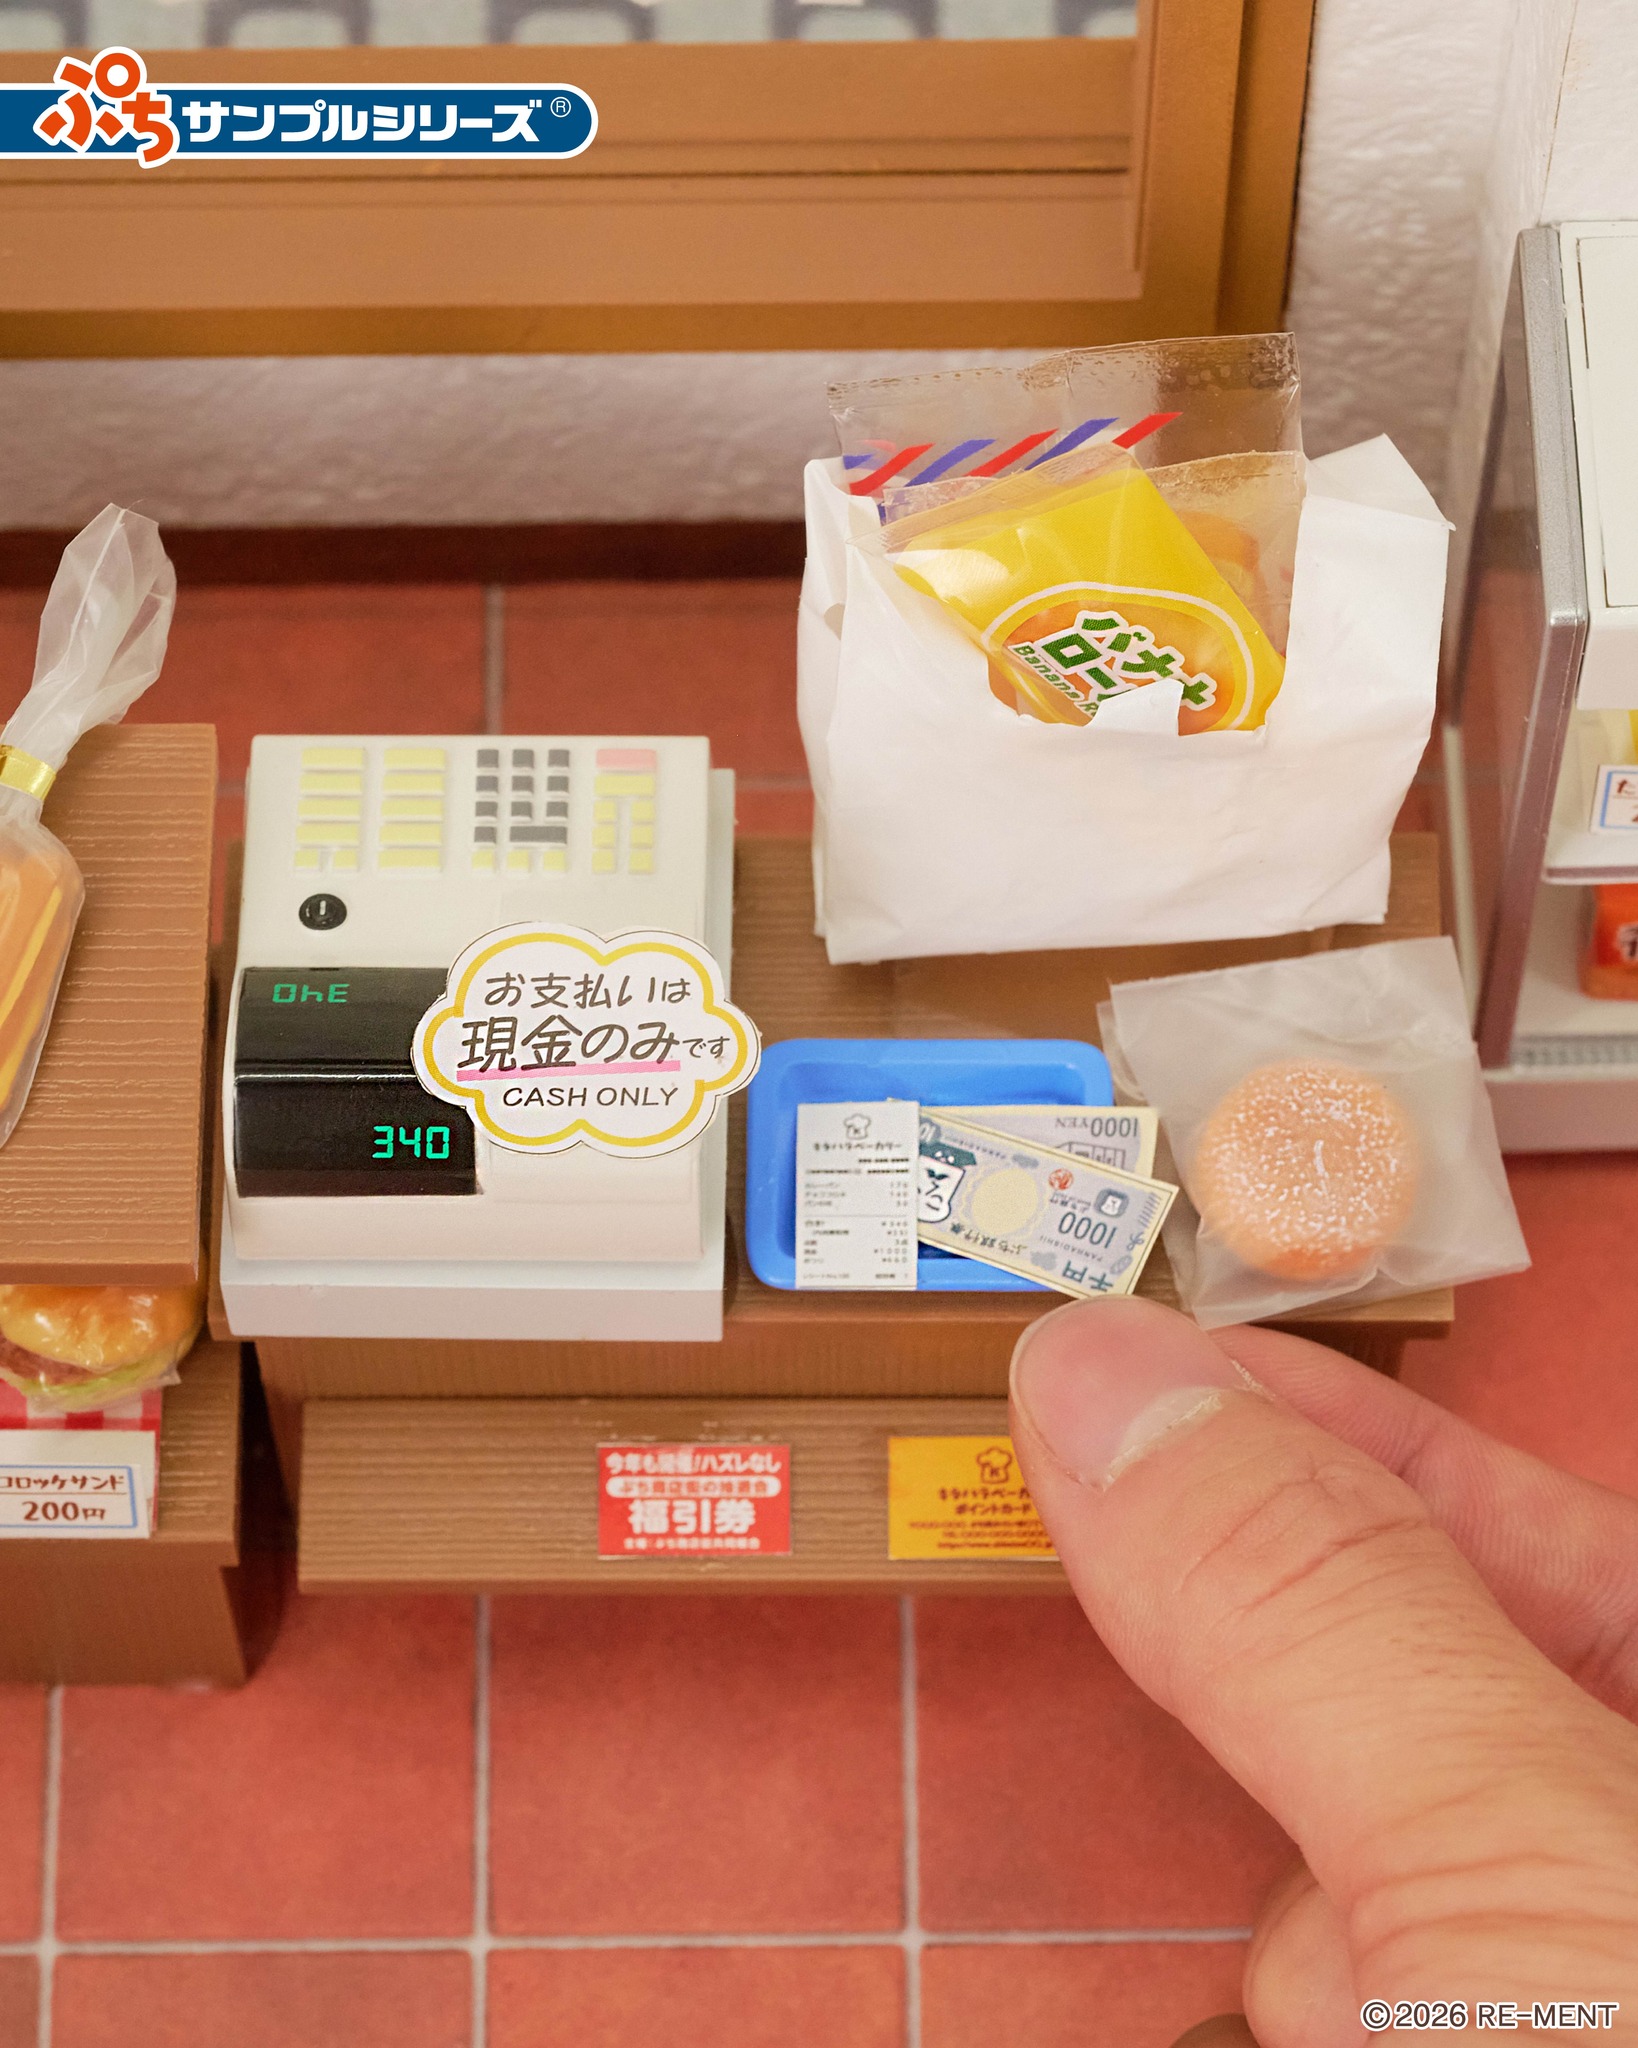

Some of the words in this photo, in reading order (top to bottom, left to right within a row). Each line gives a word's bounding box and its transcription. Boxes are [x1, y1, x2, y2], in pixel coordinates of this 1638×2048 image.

[1011, 643, 1082, 700] Banana
[1041, 632, 1136, 703] ロー
[484, 971, 692, 1010] お支払いは
[457, 1014, 731, 1072] 現金のみです
[503, 1087, 587, 1107] CASH
[596, 1086, 679, 1107] ONLY
[371, 1125, 451, 1160] 340
[1058, 1211, 1117, 1250] 1000
[1061, 1260, 1114, 1293] 千円
[21, 1500, 107, 1522] 200円
[628, 1498, 756, 1535] 福引券
